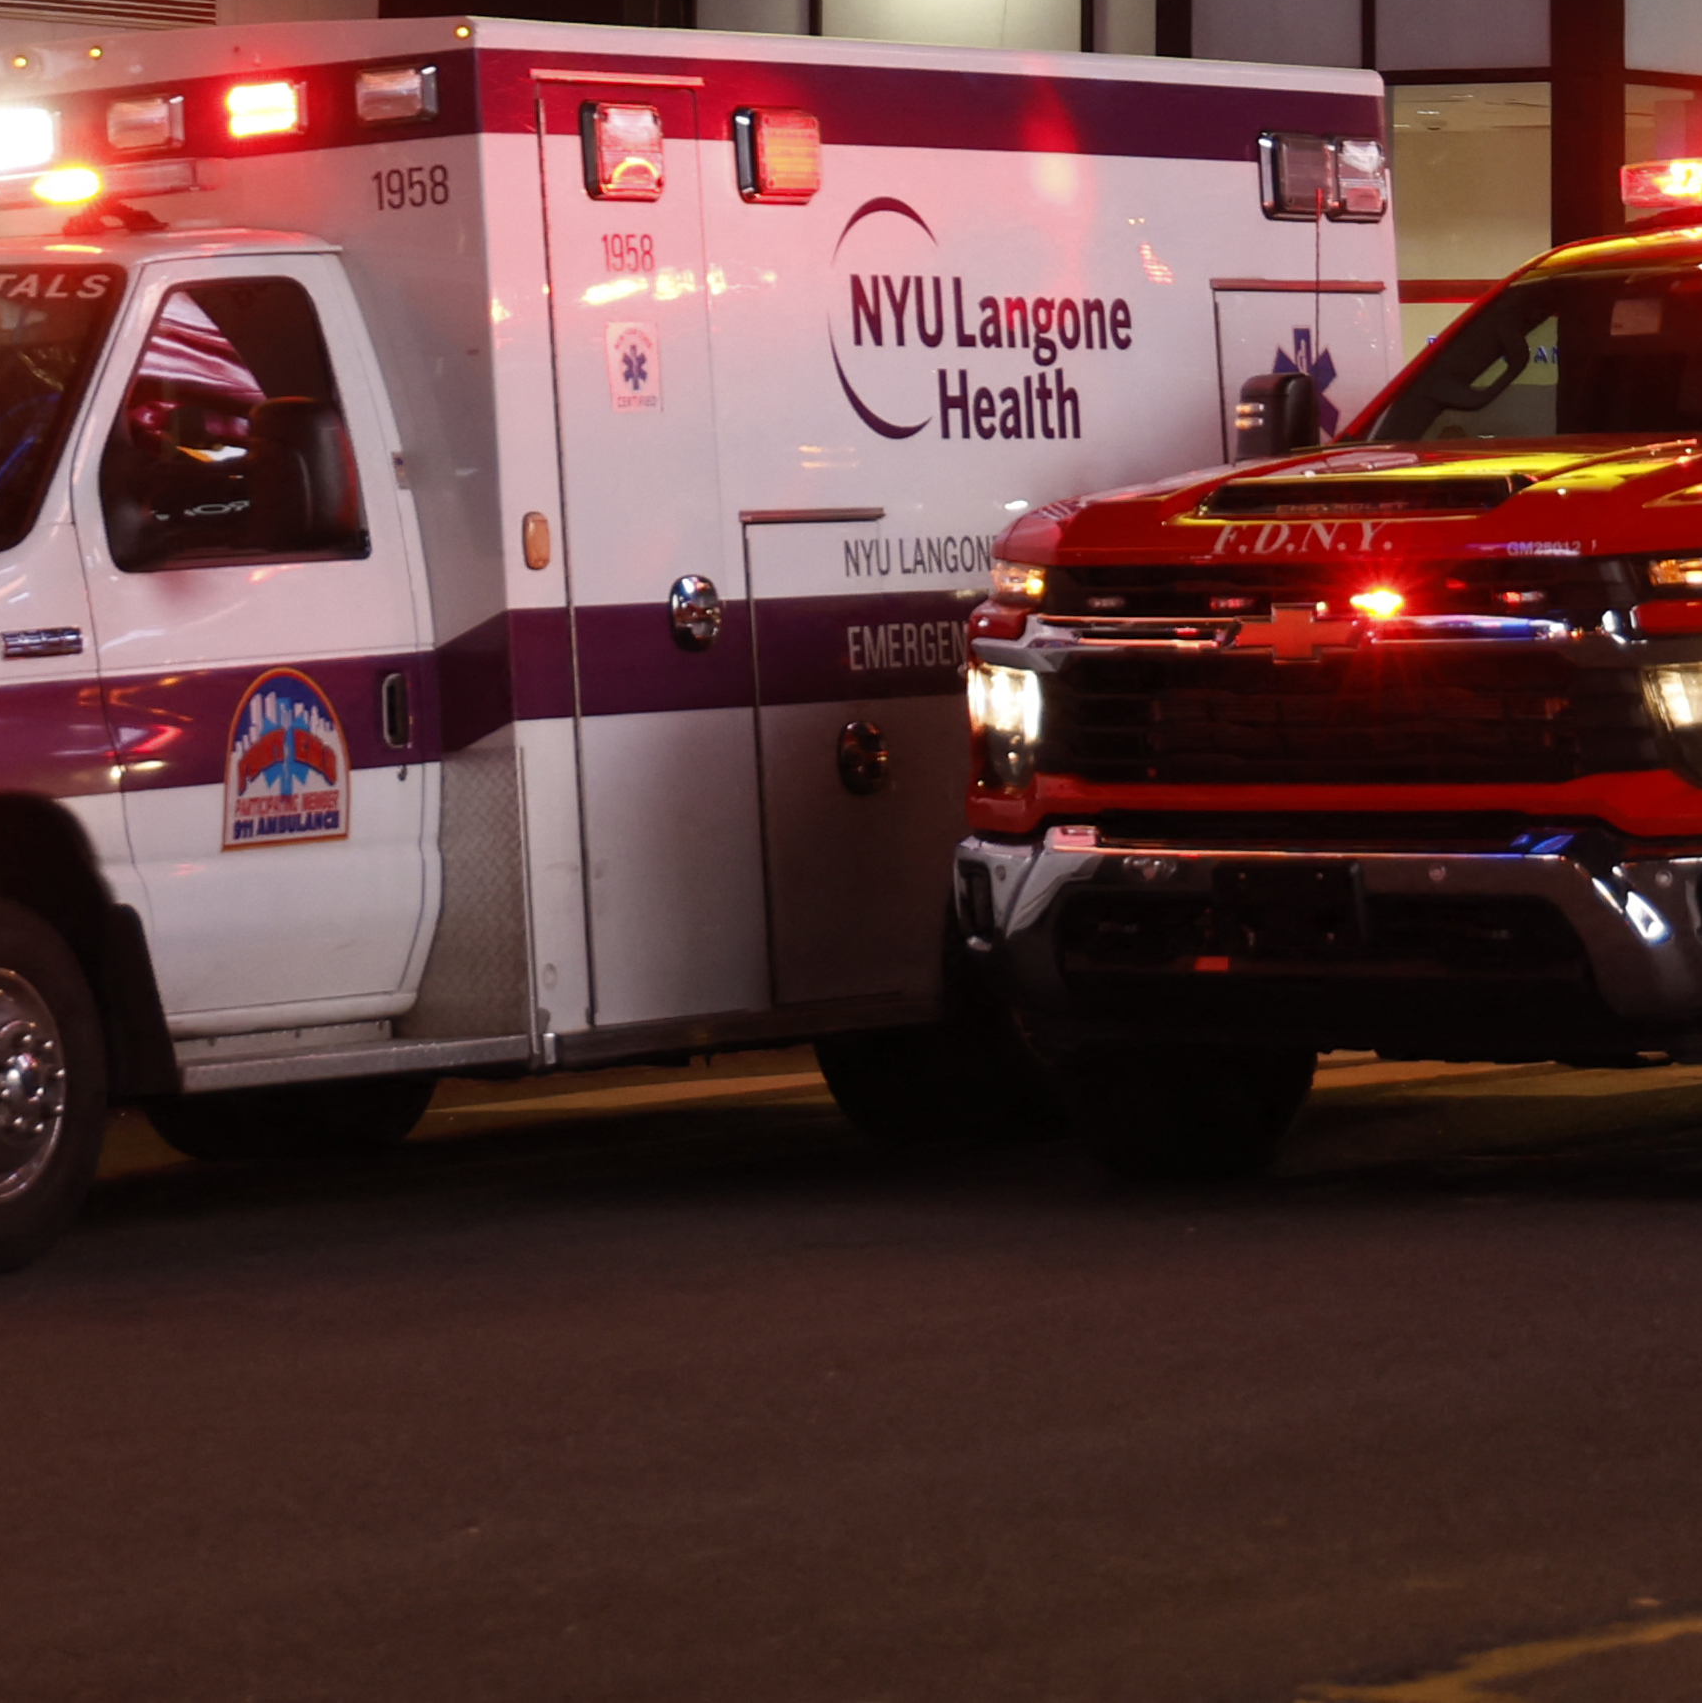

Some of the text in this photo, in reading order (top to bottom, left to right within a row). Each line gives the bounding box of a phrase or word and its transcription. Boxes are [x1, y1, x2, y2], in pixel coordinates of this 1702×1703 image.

[370, 165, 450, 213] 1958
[601, 232, 656, 273] 1958
[850, 274, 1134, 366] NYU Langone
[938, 369, 1082, 441] Health
[844, 535, 996, 578] NYU LANGON
[1211, 521, 1395, 557] F.D.N.Y.
[847, 620, 969, 672] EMERGEN
